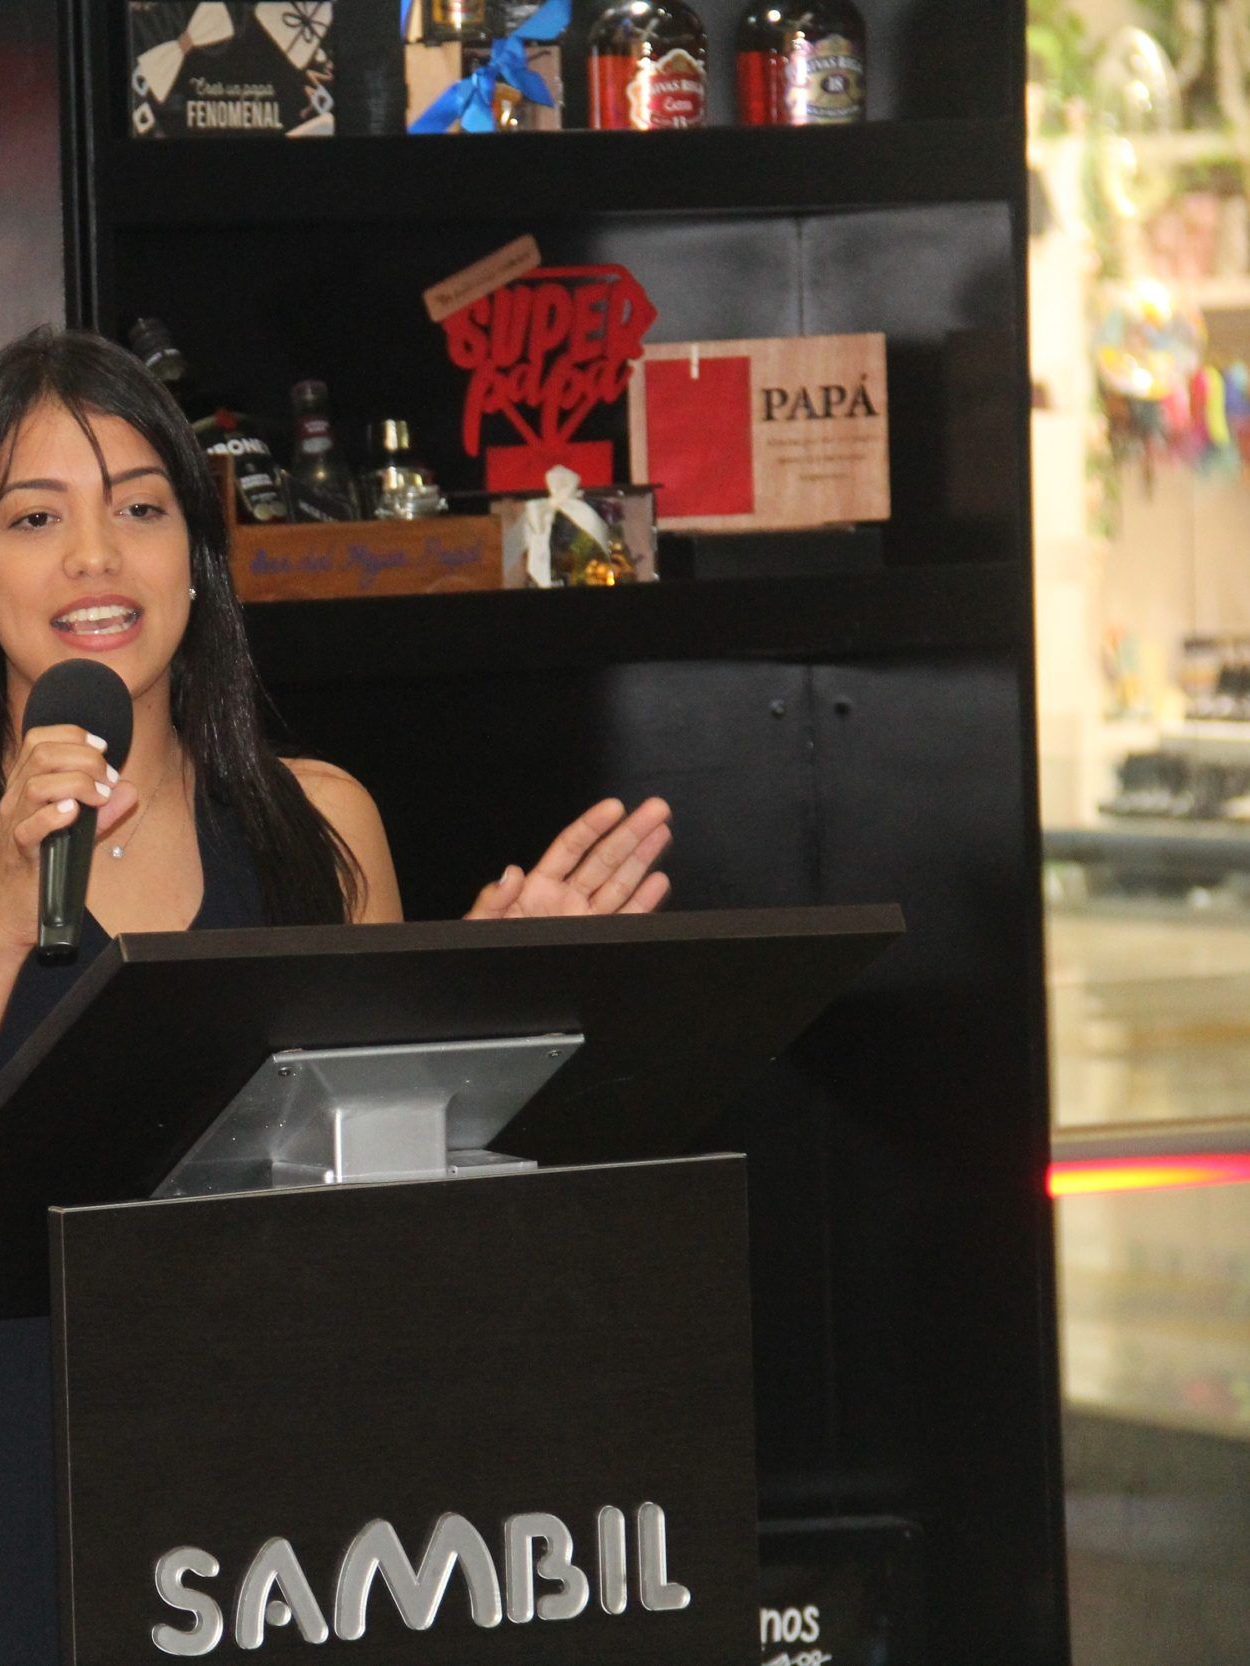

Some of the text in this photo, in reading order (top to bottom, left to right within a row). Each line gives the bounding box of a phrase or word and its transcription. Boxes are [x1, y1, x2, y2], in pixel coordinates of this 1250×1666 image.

[187, 100, 284, 128] FENOMENAL
[442, 280, 658, 370] SUPER
[760, 373, 880, 422] PAPÁ
[150, 1501, 692, 1658] SAMBIL
